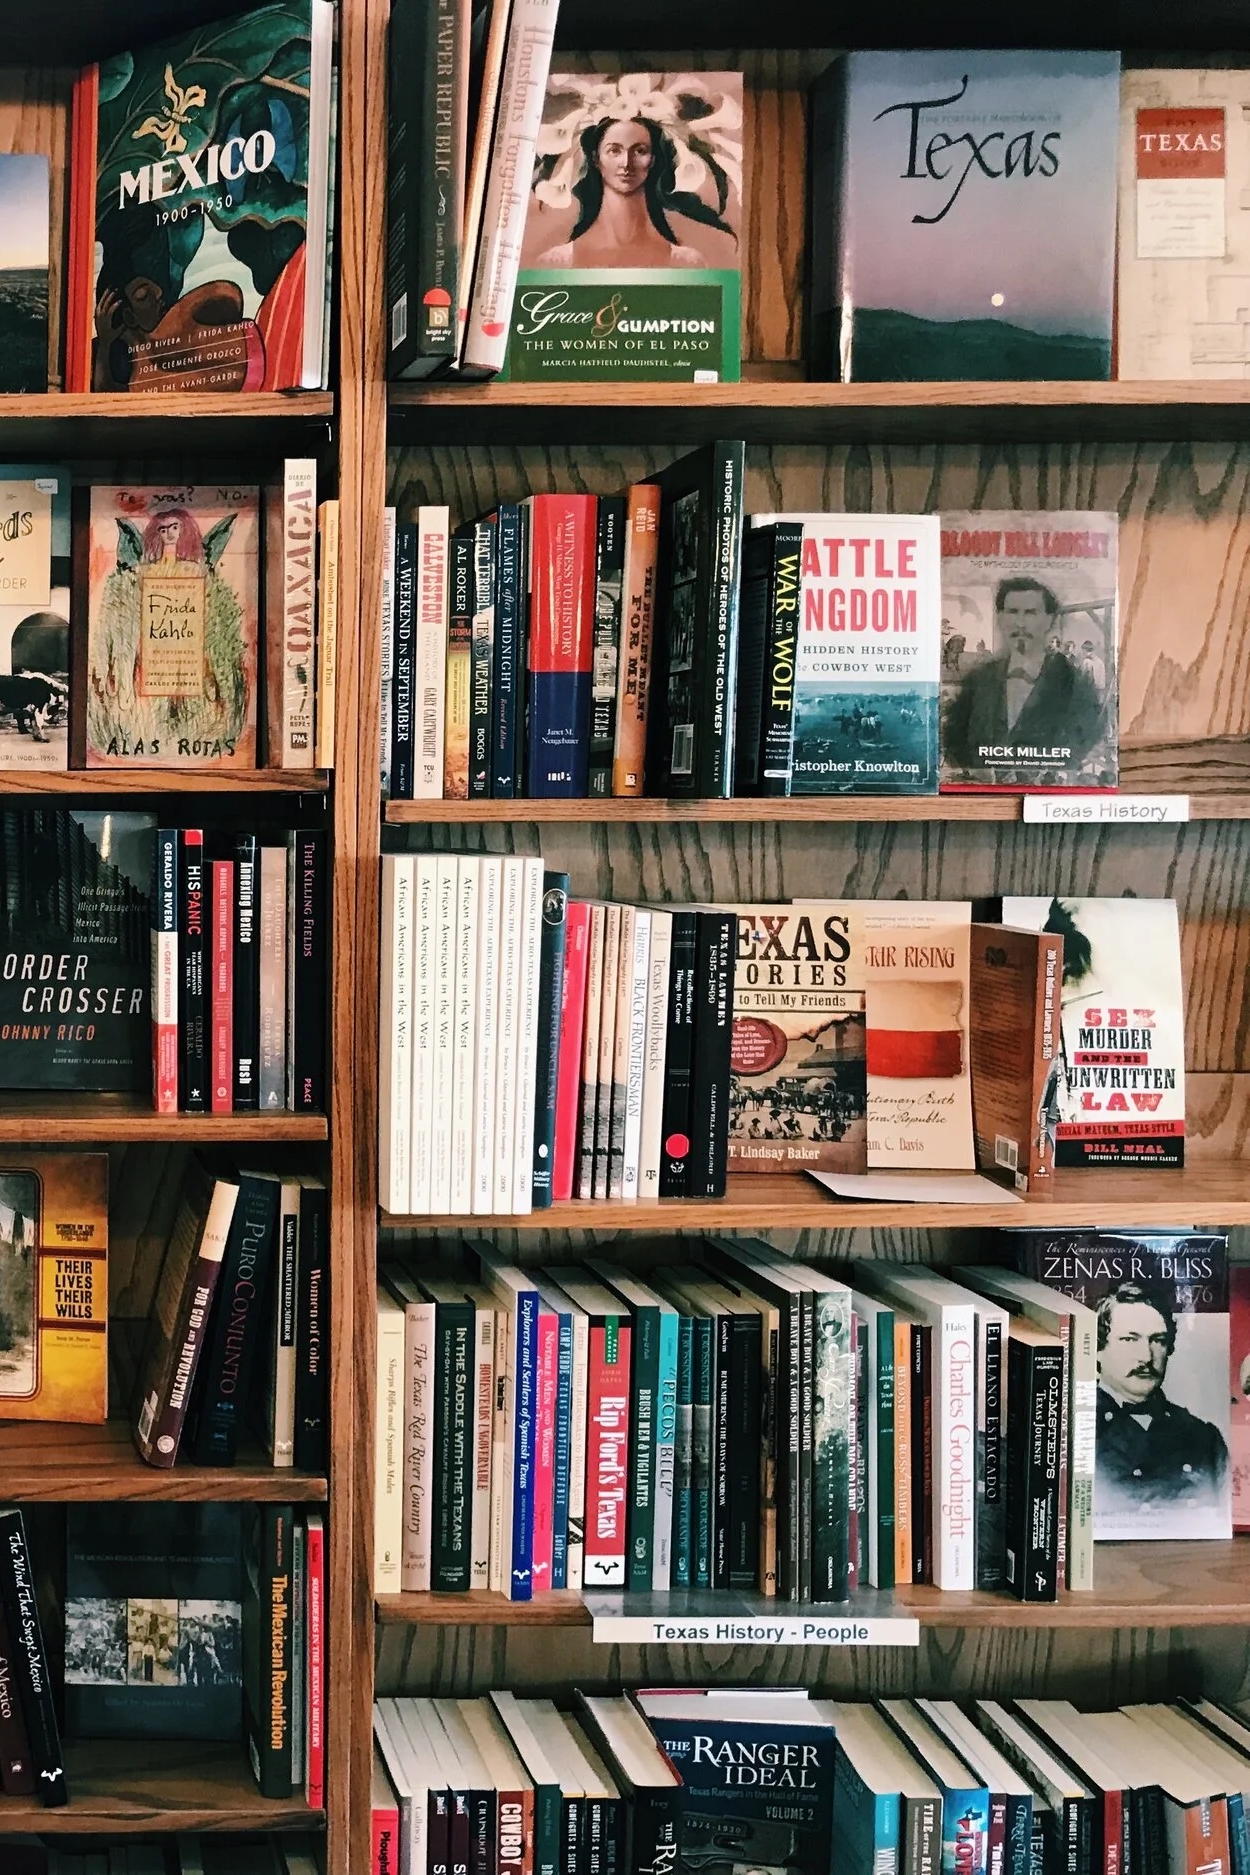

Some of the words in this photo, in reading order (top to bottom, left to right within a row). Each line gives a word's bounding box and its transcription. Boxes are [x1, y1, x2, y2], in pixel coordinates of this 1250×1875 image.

[873, 74, 1061, 223] Texas
[1140, 134, 1222, 151] TEXAS
[119, 130, 275, 209] MEXICO
[156, 195, 232, 226] 1900-1950
[516, 291, 592, 334] Grace
[591, 292, 629, 338] &
[618, 320, 714, 333] GUMPTION
[128, 342, 151, 354] DIEGO
[155, 337, 181, 348] RIVERA
[198, 328, 222, 339] FRIDA
[227, 321, 255, 333] KAHLO
[524, 340, 553, 350] THE
[560, 340, 618, 350] WOMEN
[625, 340, 644, 350] OF
[650, 340, 666, 350] EL
[673, 340, 709, 350] PASO
[723, 460, 733, 514] HISTORIC
[422, 534, 443, 624] GALVESTON
[721, 564, 729, 580] OF
[776, 554, 797, 614] WAR
[148, 595, 196, 614] Frida
[719, 582, 728, 630] HEROES
[150, 620, 194, 639] Kahlo
[775, 619, 783, 635] THE
[786, 622, 794, 632] OF
[718, 634, 726, 649] OF
[804, 646, 855, 655] HIDDEN
[861, 646, 918, 656] HISTORY
[716, 652, 725, 675] THE
[813, 663, 869, 673] COWBOY
[875, 663, 911, 673] WEST
[772, 637, 796, 712] WOLF
[715, 678, 724, 701] OLD
[714, 703, 723, 736] WEST
[106, 739, 159, 755] ALAS
[178, 739, 235, 756] ROTAS
[979, 746, 1014, 757] RICK
[1018, 746, 1071, 758] MILLER
[855, 761, 919, 773] Knowlton
[1042, 802, 1093, 818] Texas
[1100, 803, 1168, 821] History
[188, 866, 201, 935] HISPANIC
[22, 987, 143, 1014] CROSSER
[739, 994, 750, 1006] to
[754, 994, 776, 1006] Tell
[781, 994, 797, 1007] My
[801, 994, 846, 1006] Friends
[1085, 1008, 1156, 1027] SEX
[57, 1025, 95, 1041] RICO
[1078, 1029, 1152, 1048] MURDER
[1082, 1054, 1113, 1064] AND
[1117, 1054, 1141, 1064] THE
[1067, 1069, 1175, 1089] UNWRITTEN
[1081, 1093, 1162, 1111] LAW
[741, 1146, 784, 1161] Lindsay
[788, 1146, 820, 1160] Baker
[56, 1260, 92, 1275] THEIR
[1044, 1258, 1123, 1279] ZENAS
[1131, 1258, 1152, 1279] R.
[1161, 1258, 1212, 1279] BLISS
[55, 1275, 92, 1289] LIVES
[55, 1289, 92, 1304] THEIR
[56, 1304, 92, 1319] WILLS
[949, 1340, 971, 1417] Charles
[595, 1396, 626, 1427] Rip
[597, 1431, 626, 1483] Ford's
[943, 1422, 971, 1539] Goodnight
[597, 1484, 624, 1539] Texas
[272, 1575, 287, 1603] The
[272, 1604, 287, 1668] Mexican
[653, 1624, 709, 1639] Texas
[715, 1624, 783, 1642] History
[803, 1624, 871, 1642] People
[272, 1671, 288, 1749] Revolution
[664, 1741, 690, 1751] THE
[692, 1736, 822, 1767] RANGER
[725, 1767, 816, 1788] IDEAL
[766, 1807, 802, 1819] VOLUME
[806, 1809, 813, 1819] 2
